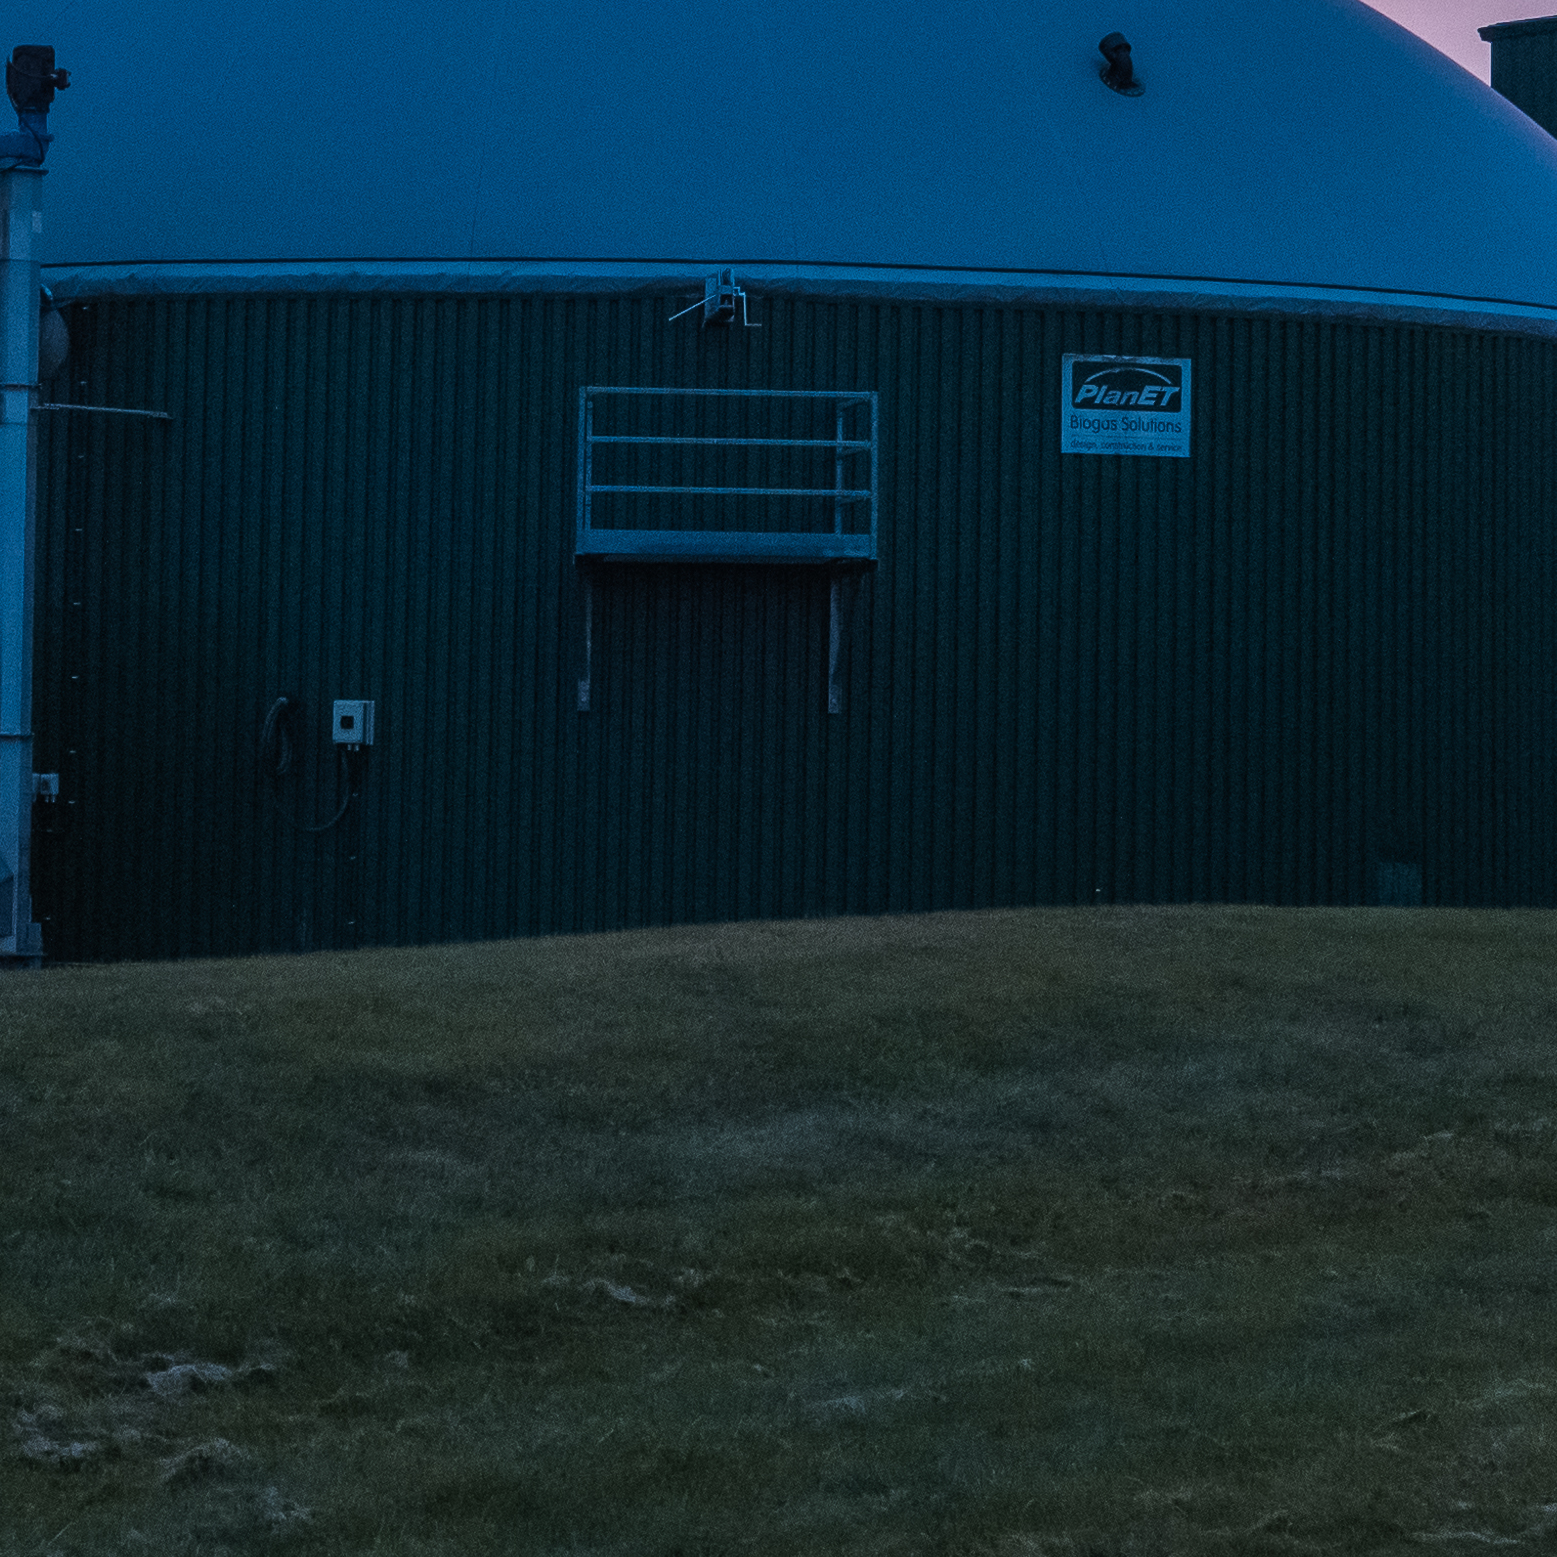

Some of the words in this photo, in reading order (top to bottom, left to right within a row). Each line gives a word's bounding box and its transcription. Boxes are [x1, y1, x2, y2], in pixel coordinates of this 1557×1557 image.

[1075, 384, 1180, 406] PlanET
[1070, 415, 1117, 433] Biogas
[1121, 417, 1182, 433] Solutions
